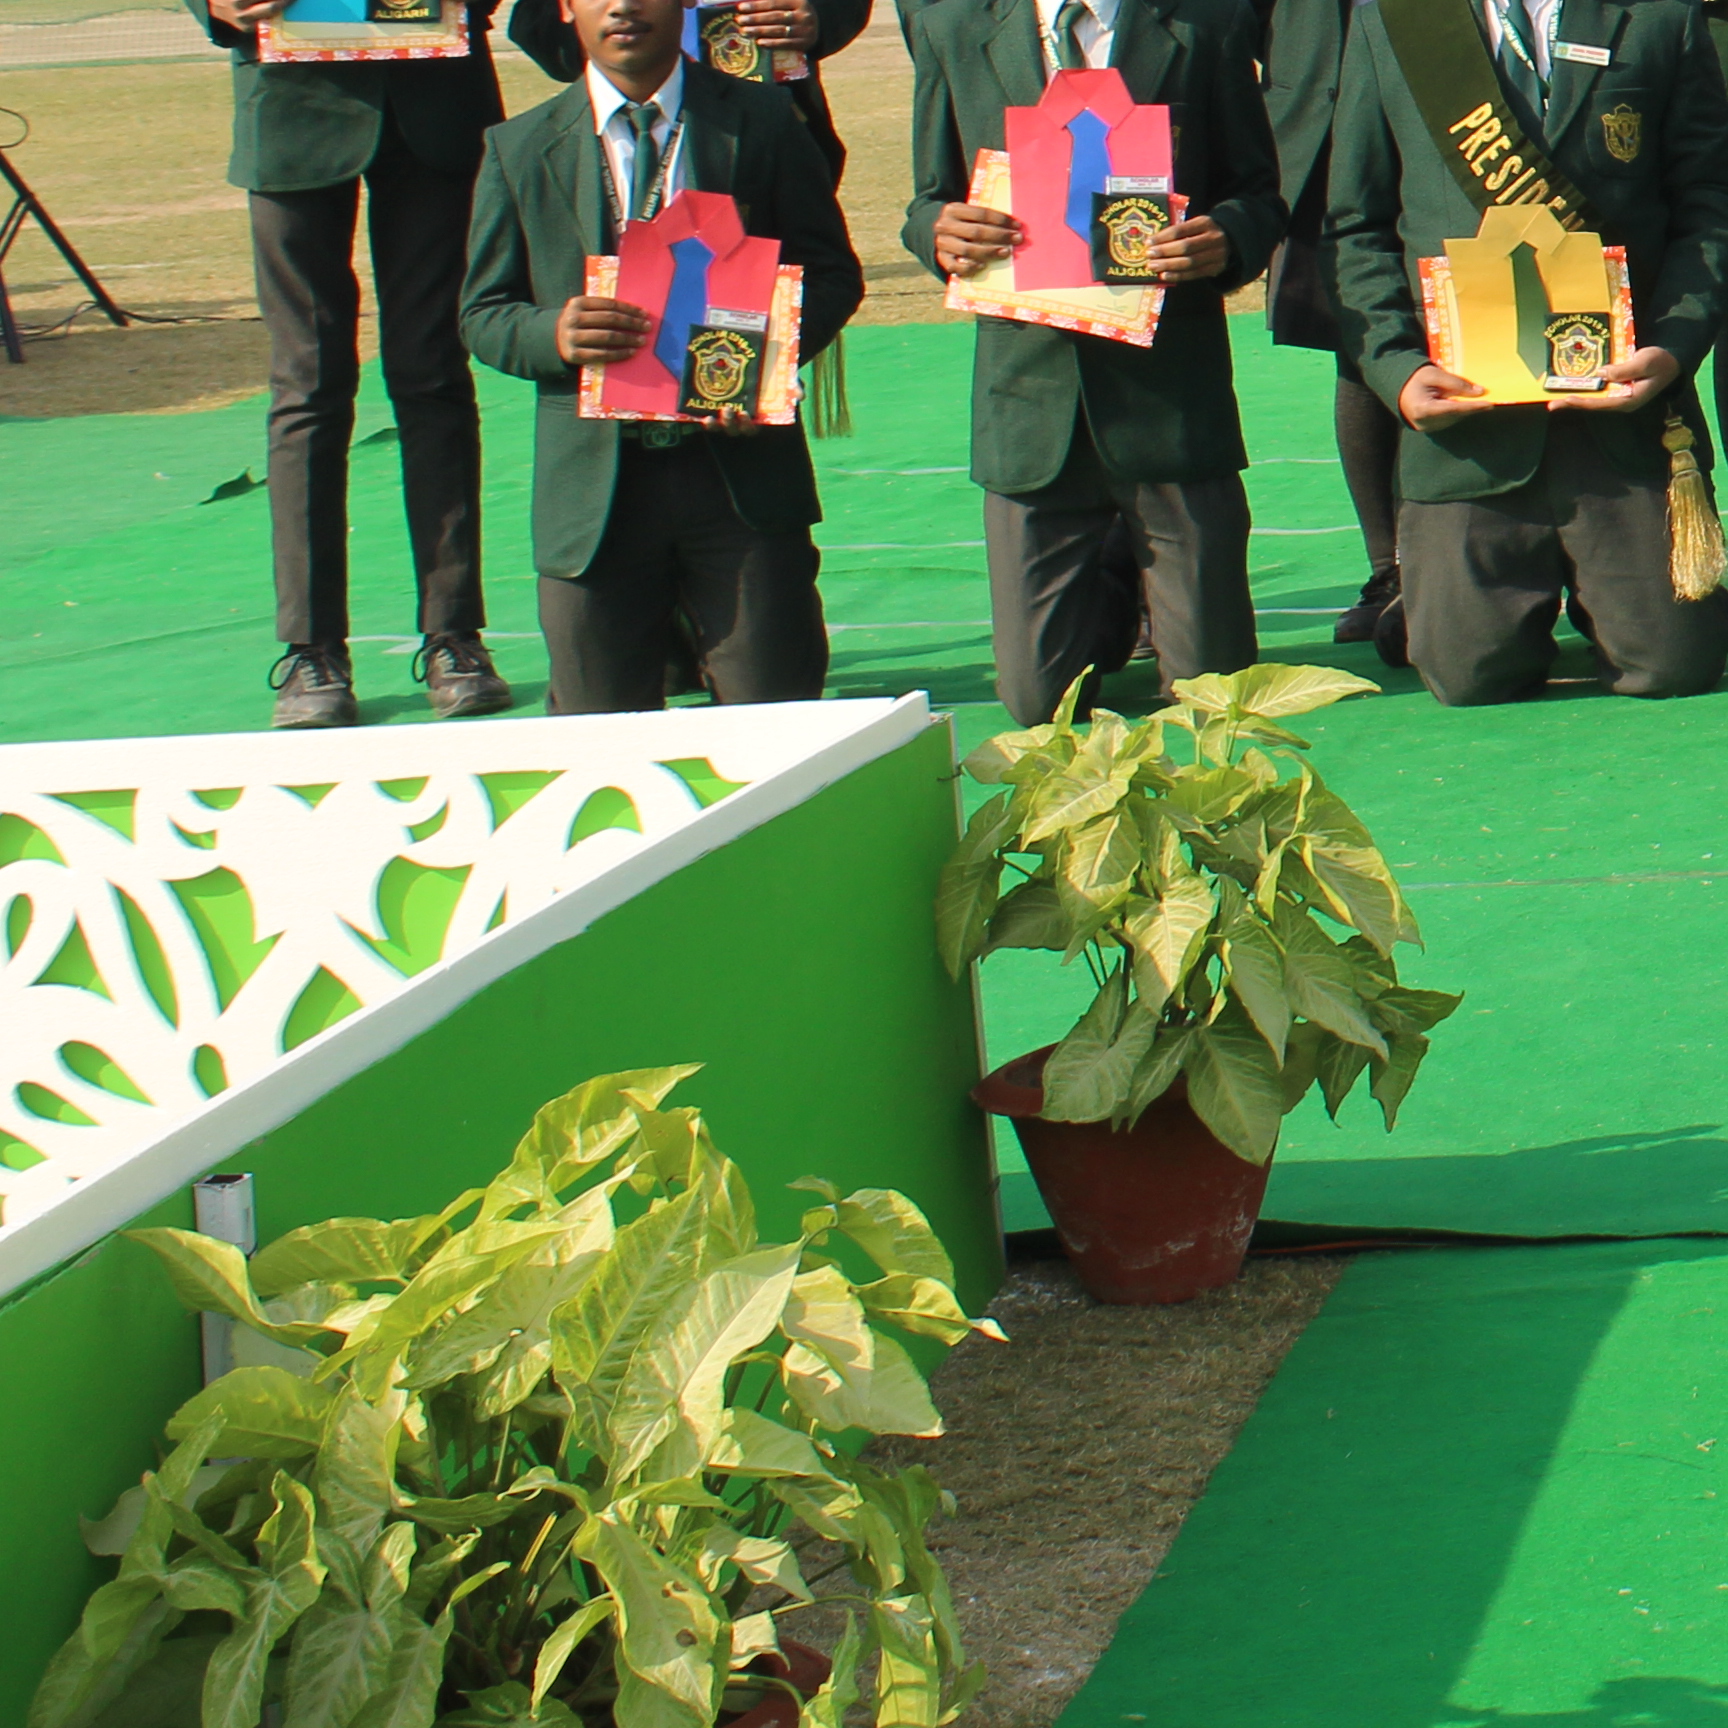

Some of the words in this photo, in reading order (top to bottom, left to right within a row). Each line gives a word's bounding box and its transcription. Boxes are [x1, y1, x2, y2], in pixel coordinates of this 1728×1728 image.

[374, 8, 429, 19] ALIGARH
[1099, 198, 1137, 223] SCHOLAR
[1543, 313, 1582, 339] SCHOLAR
[685, 398, 744, 412] ALIGARH
